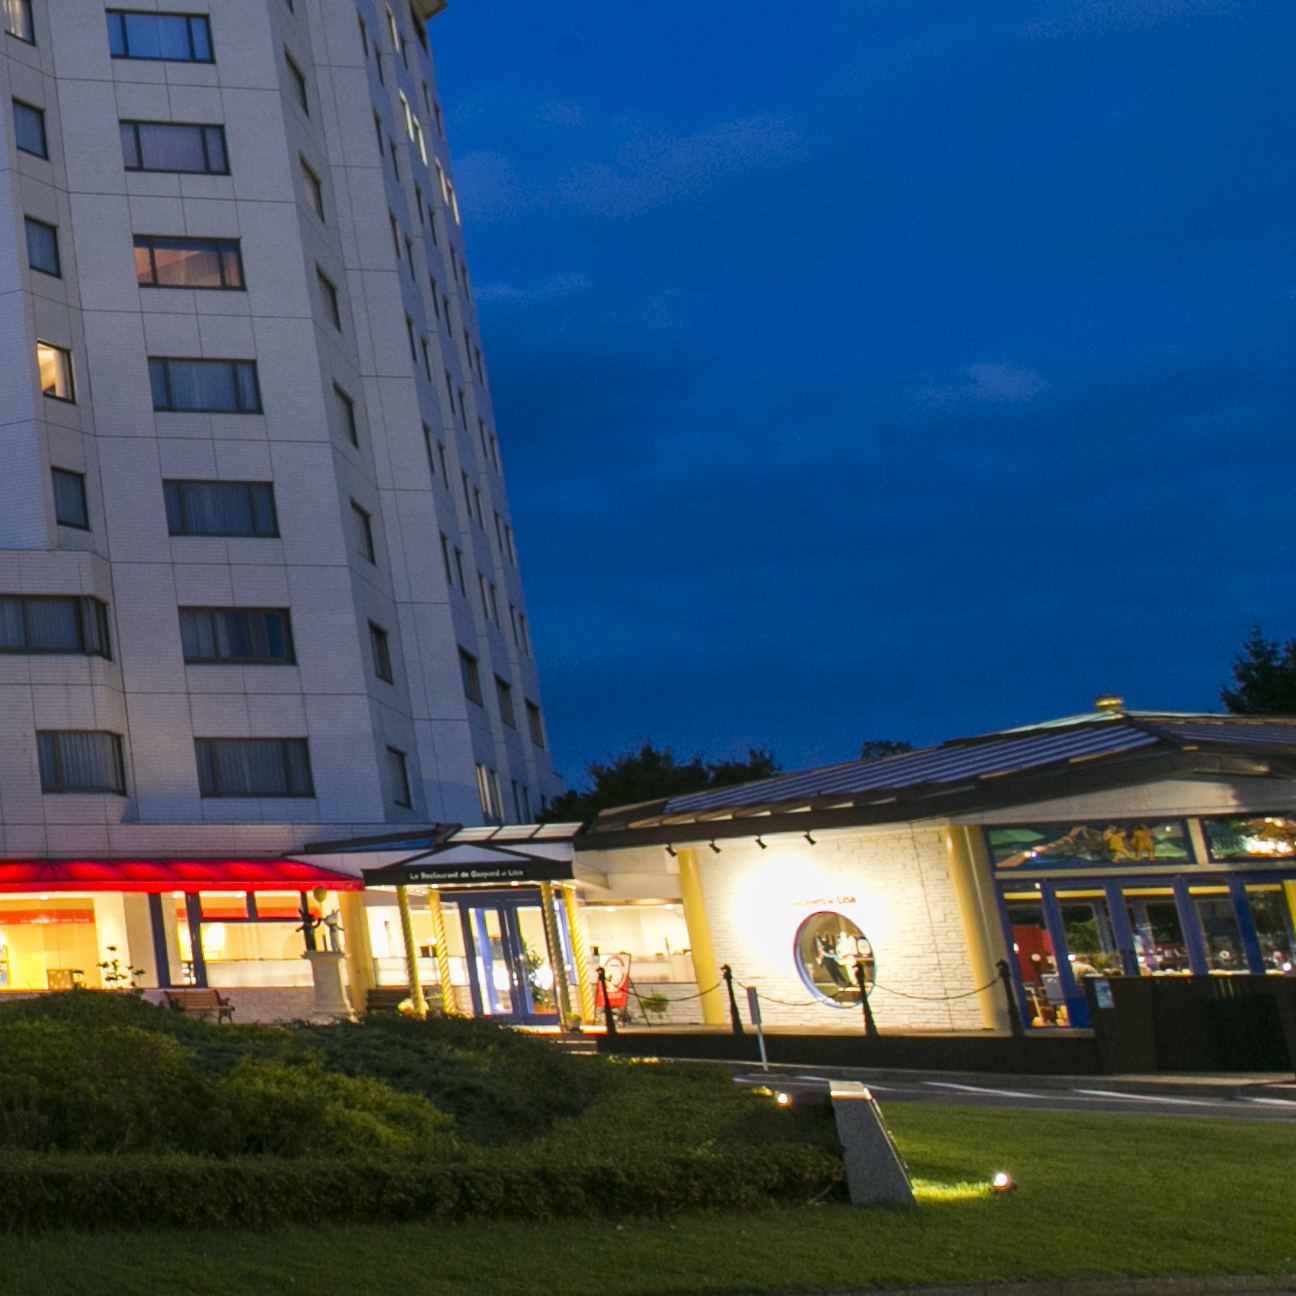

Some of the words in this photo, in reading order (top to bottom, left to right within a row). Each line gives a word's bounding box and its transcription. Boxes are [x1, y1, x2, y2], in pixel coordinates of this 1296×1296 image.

[420, 871, 459, 880] Restaurant
[470, 869, 500, 879] Gaspard
[508, 869, 524, 877] Lisa
